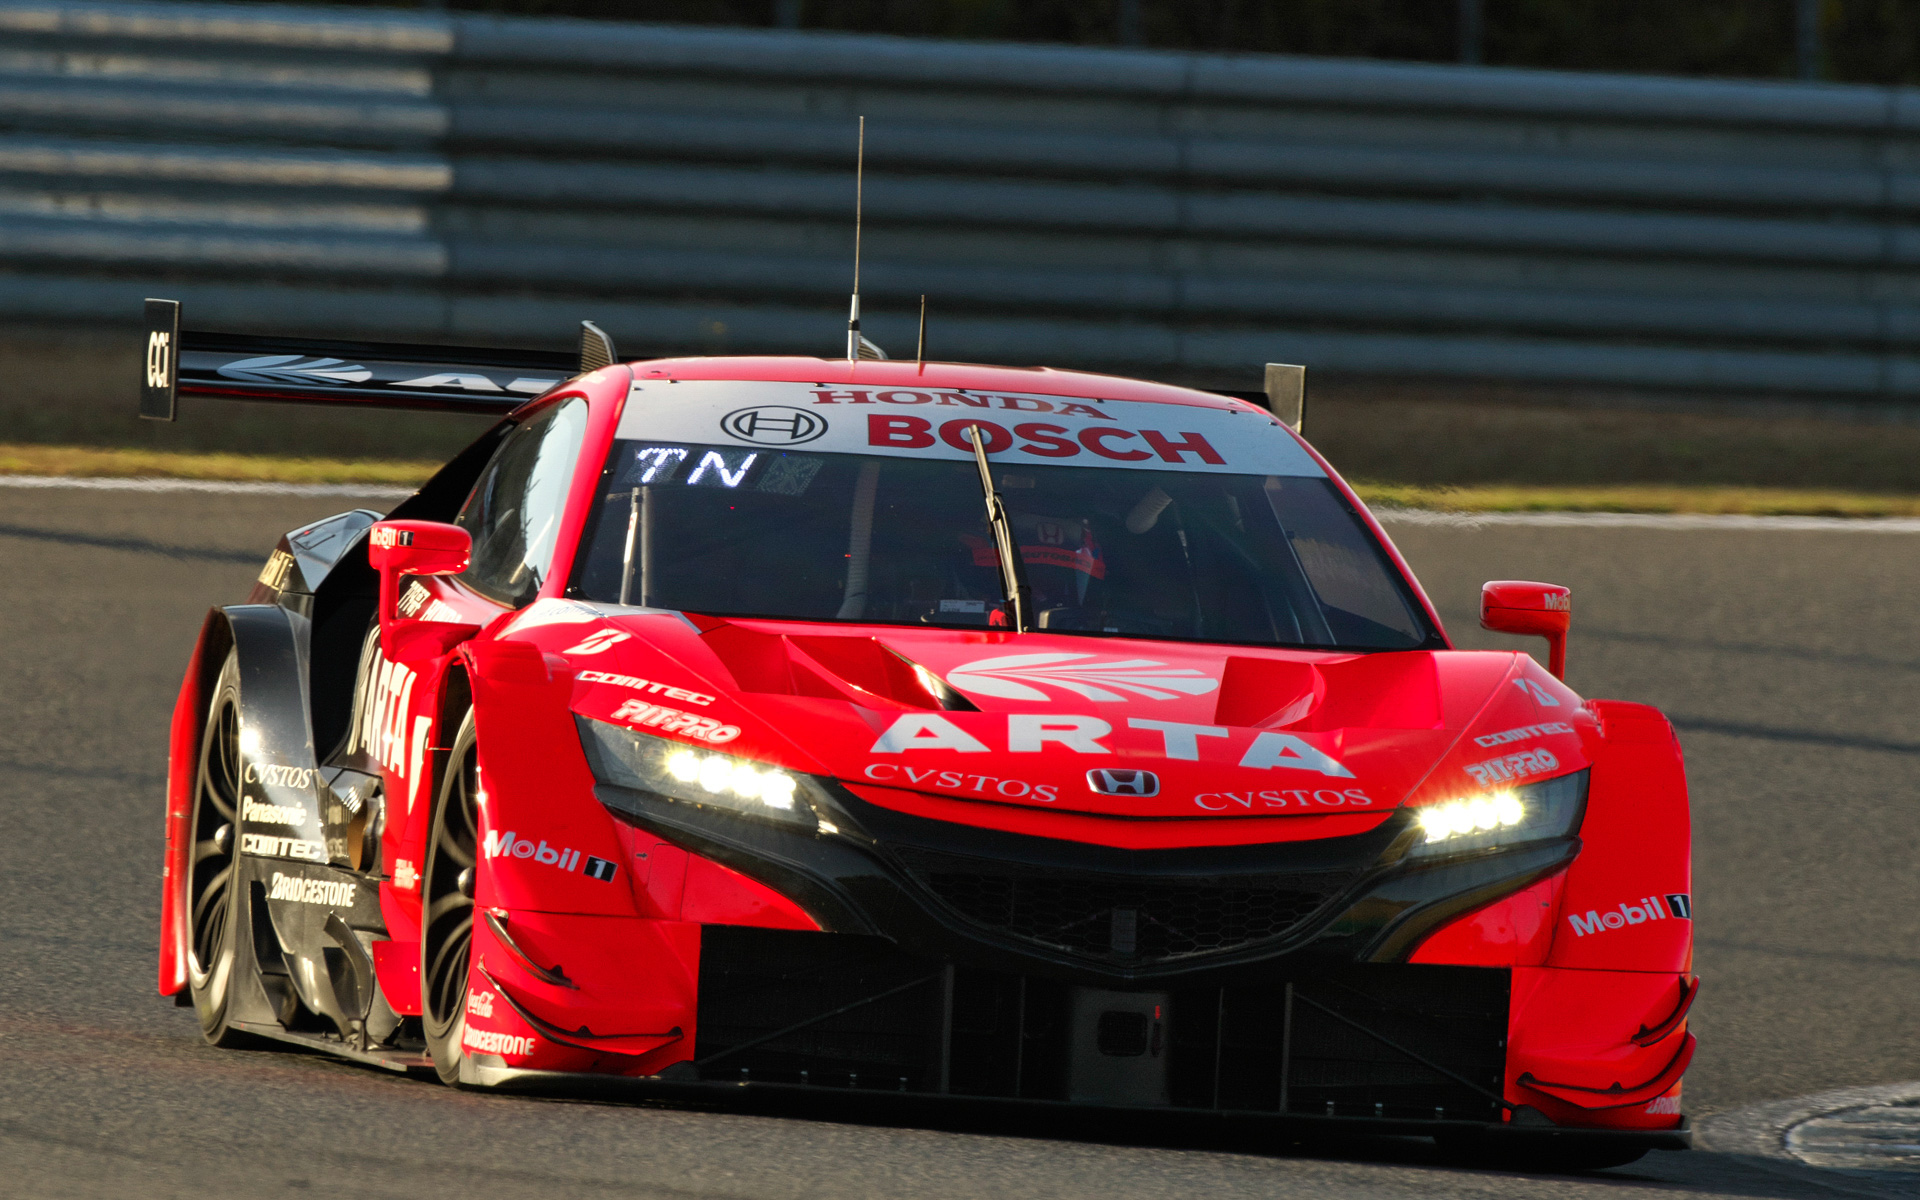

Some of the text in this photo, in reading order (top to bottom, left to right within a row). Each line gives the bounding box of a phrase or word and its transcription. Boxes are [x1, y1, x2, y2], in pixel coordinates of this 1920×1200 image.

[810, 390, 1116, 421] HONDA
[866, 412, 1228, 466] BOSCH
[369, 527, 396, 547] Mobil
[576, 670, 716, 706] COMTEC
[870, 714, 1356, 779] ARTA
[1474, 722, 1573, 747] COMTEC
[245, 763, 314, 789] CVSTOS
[864, 763, 1059, 803] CVSTOS
[242, 796, 307, 827] Panasonic
[1194, 789, 1373, 812] CVSTOS
[241, 833, 322, 860] COMTEC
[483, 830, 581, 872] Mobil
[270, 872, 357, 908] BRIDGESTONE
[1568, 896, 1666, 937] Mobil
[463, 1023, 536, 1057] BRIDGESTONE
